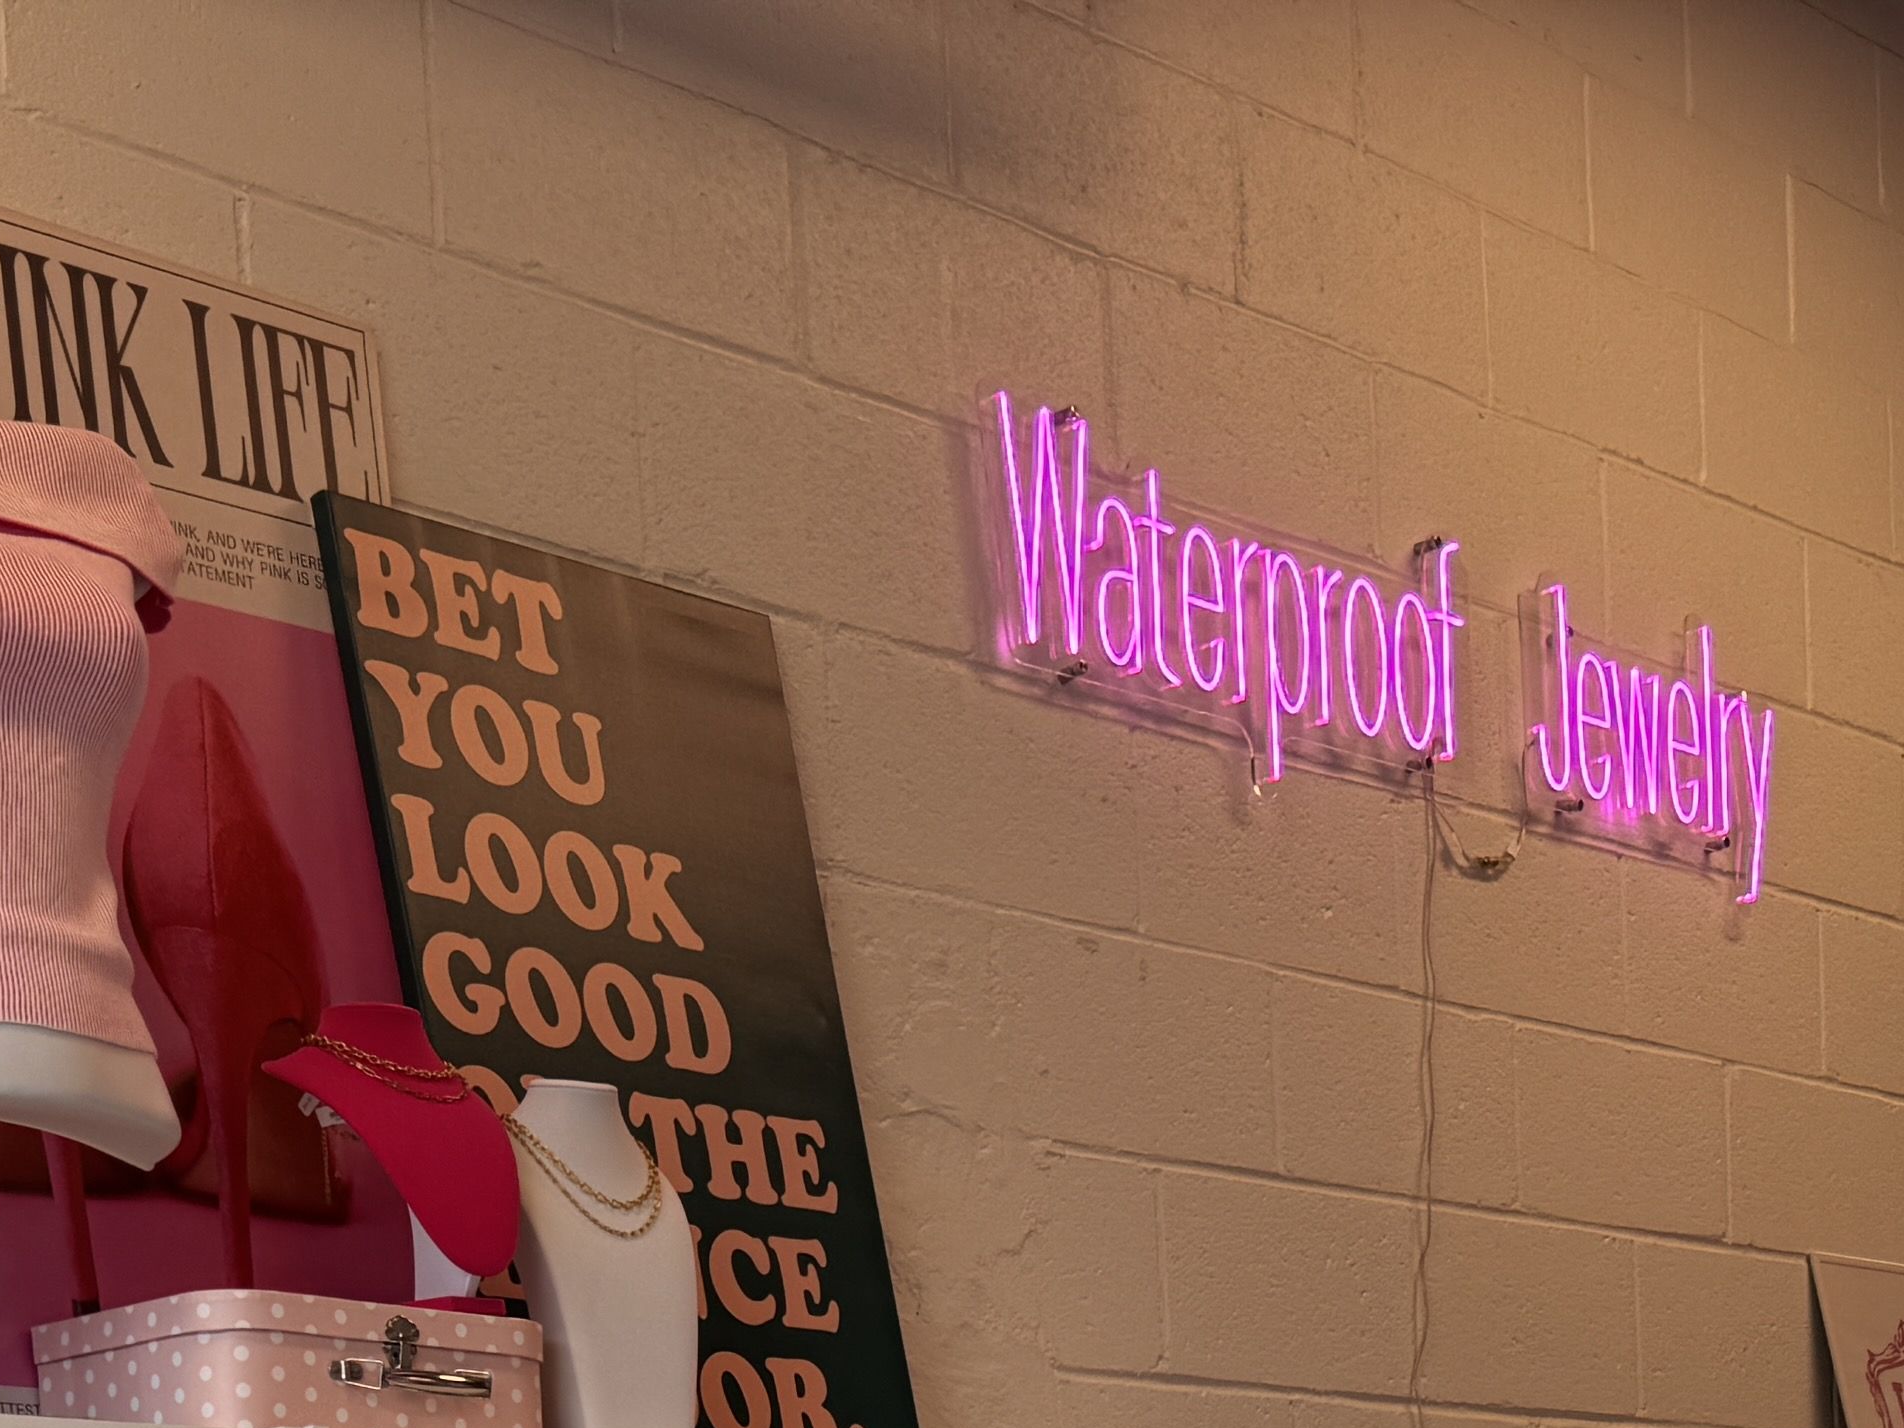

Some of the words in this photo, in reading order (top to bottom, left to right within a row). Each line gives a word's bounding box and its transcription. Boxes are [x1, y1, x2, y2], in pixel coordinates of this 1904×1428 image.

[181, 299, 377, 503] LIFE
[170, 520, 200, 542] INK,
[207, 530, 236, 549] AND
[186, 543, 215, 563] AND
[221, 552, 253, 572] WHY
[261, 562, 292, 582] PINK
[297, 570, 309, 585] IS
[343, 526, 562, 675] BET
[994, 389, 1464, 783] Waterproof
[1532, 583, 1774, 905] Jewelry
[365, 657, 604, 805] YOU
[391, 794, 704, 950] LOOK
[422, 931, 732, 1075] GOOD
[629, 1091, 838, 1214] THE
